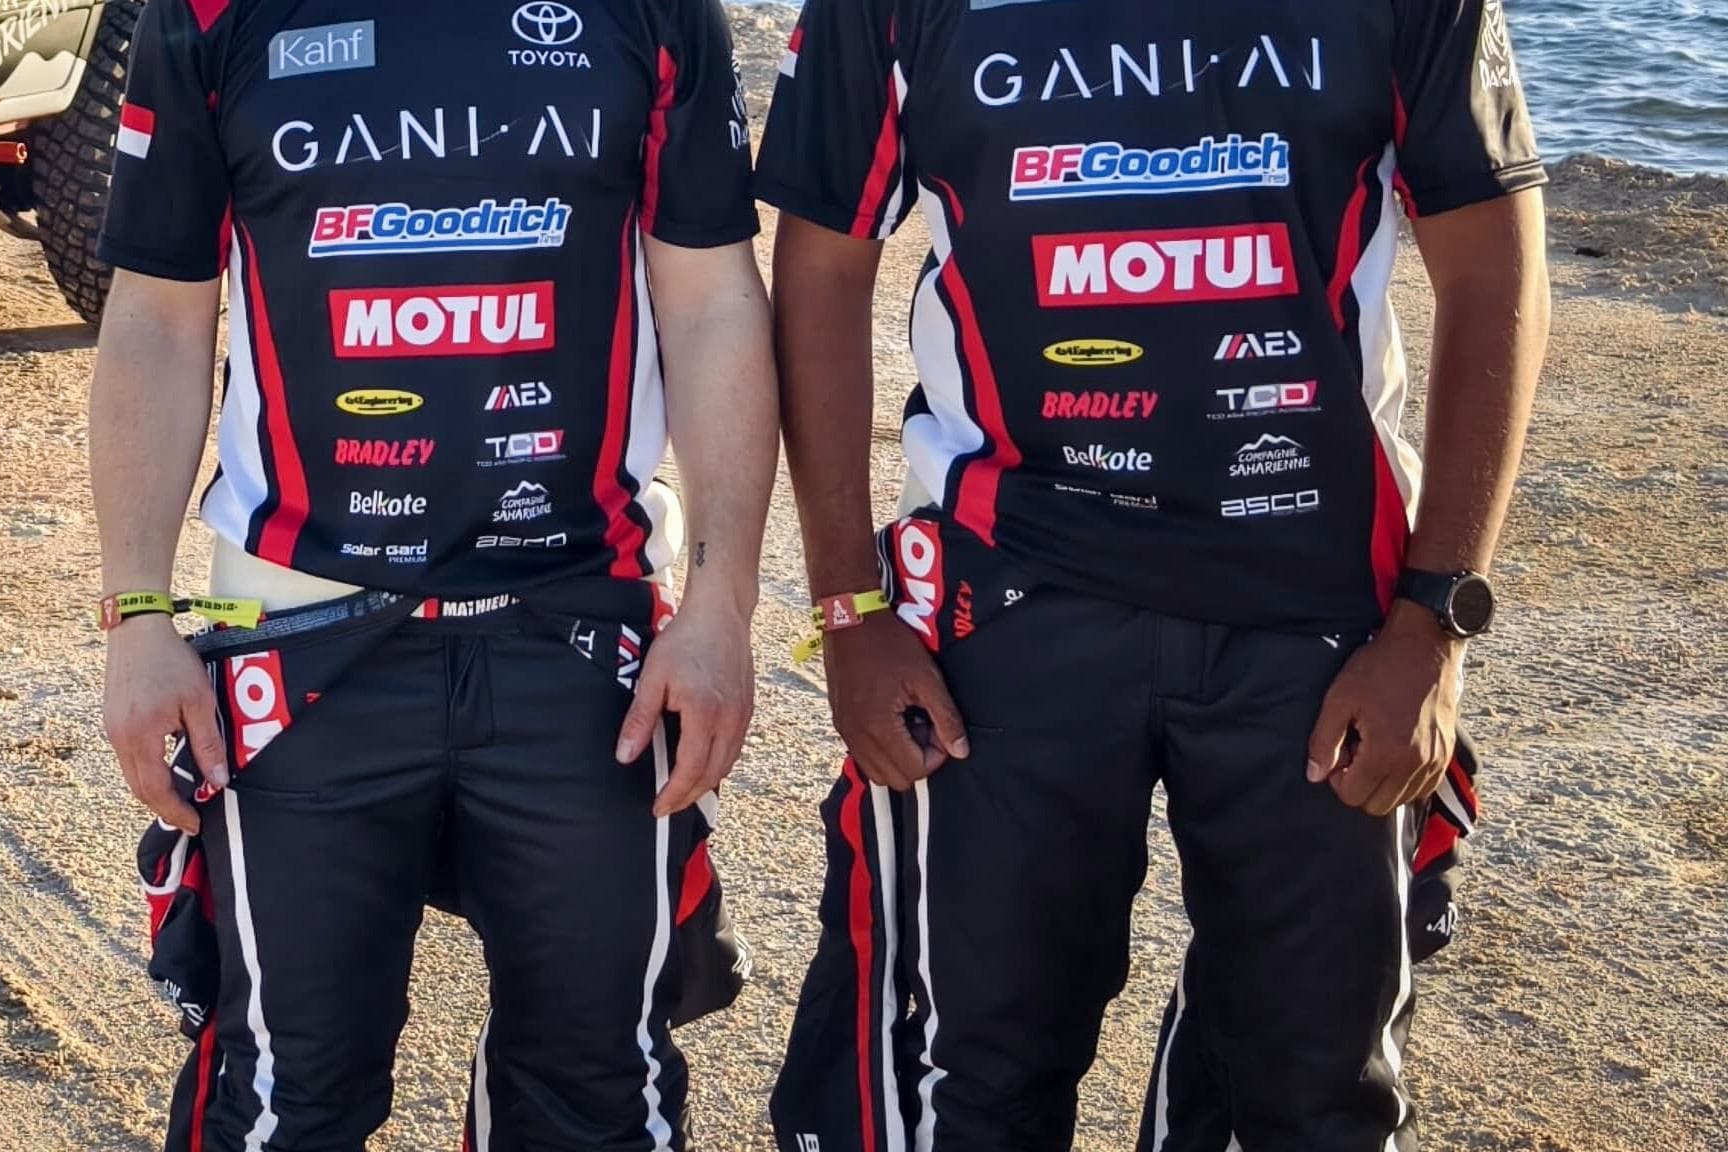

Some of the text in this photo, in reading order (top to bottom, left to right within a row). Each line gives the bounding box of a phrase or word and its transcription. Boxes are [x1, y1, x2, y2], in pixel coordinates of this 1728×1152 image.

[279, 27, 364, 70] Kahf
[507, 49, 592, 69] TOYOTA
[1014, 135, 1288, 184] BFGoodrich
[313, 200, 570, 242] BFGoodrich
[1048, 234, 1284, 295] MOTUL
[343, 292, 546, 347] MOTUL
[1042, 391, 1158, 419] BRADLEY
[1216, 383, 1310, 410] TCD
[335, 438, 434, 466] BRADLEY
[1062, 443, 1153, 471] Belkote
[1238, 447, 1299, 463] COMPAGNIE
[1229, 456, 1312, 477] SAHARIENNE
[349, 489, 427, 517] Belkote
[341, 539, 427, 556] Solar Gard
[441, 593, 510, 617] MATHIEU
